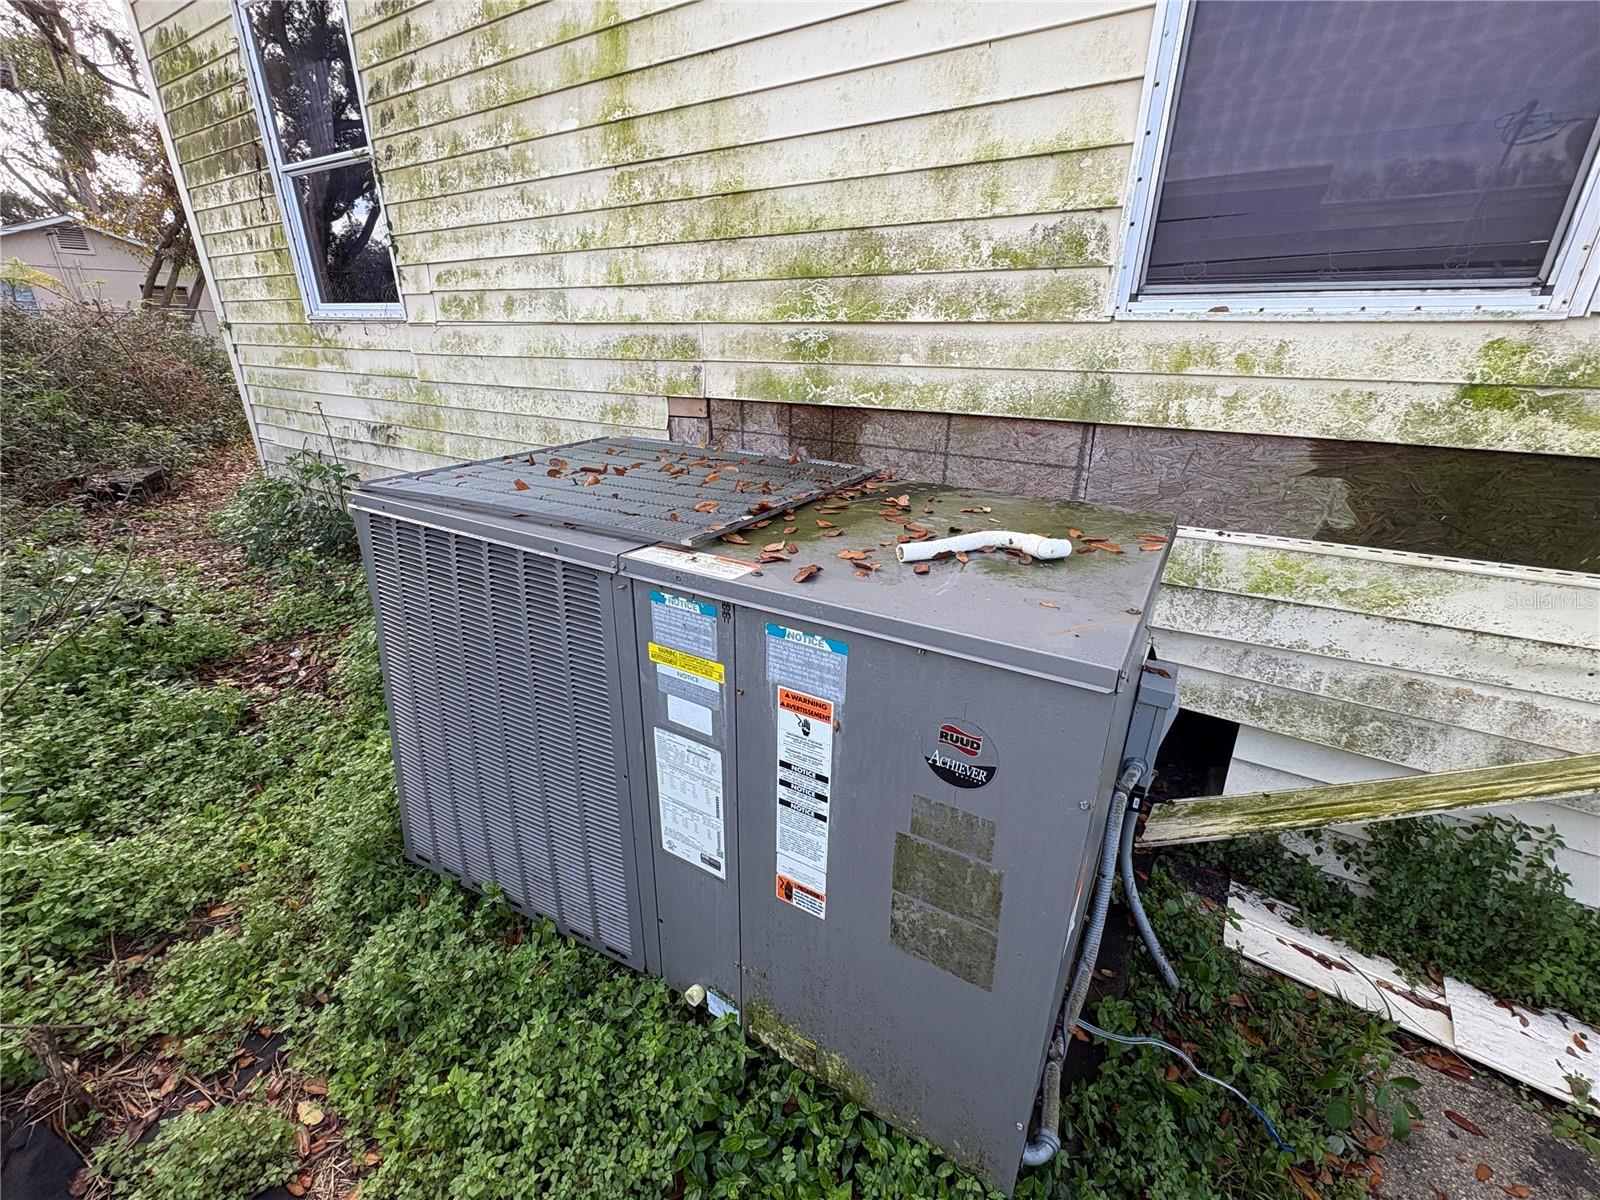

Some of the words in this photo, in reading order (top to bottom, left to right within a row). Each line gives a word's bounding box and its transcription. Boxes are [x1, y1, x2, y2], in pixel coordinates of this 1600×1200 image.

[667, 596, 698, 612] NOTICE
[787, 630, 825, 649] NOTICE
[676, 670, 699, 684] NOTICE
[791, 693, 827, 710] WARNING
[785, 702, 831, 722] AVERTISSEMENT
[939, 730, 981, 751] RUUD
[791, 764, 817, 779] NOTICE
[790, 783, 816, 798] NOTICE
[790, 802, 815, 818] NOTICE
